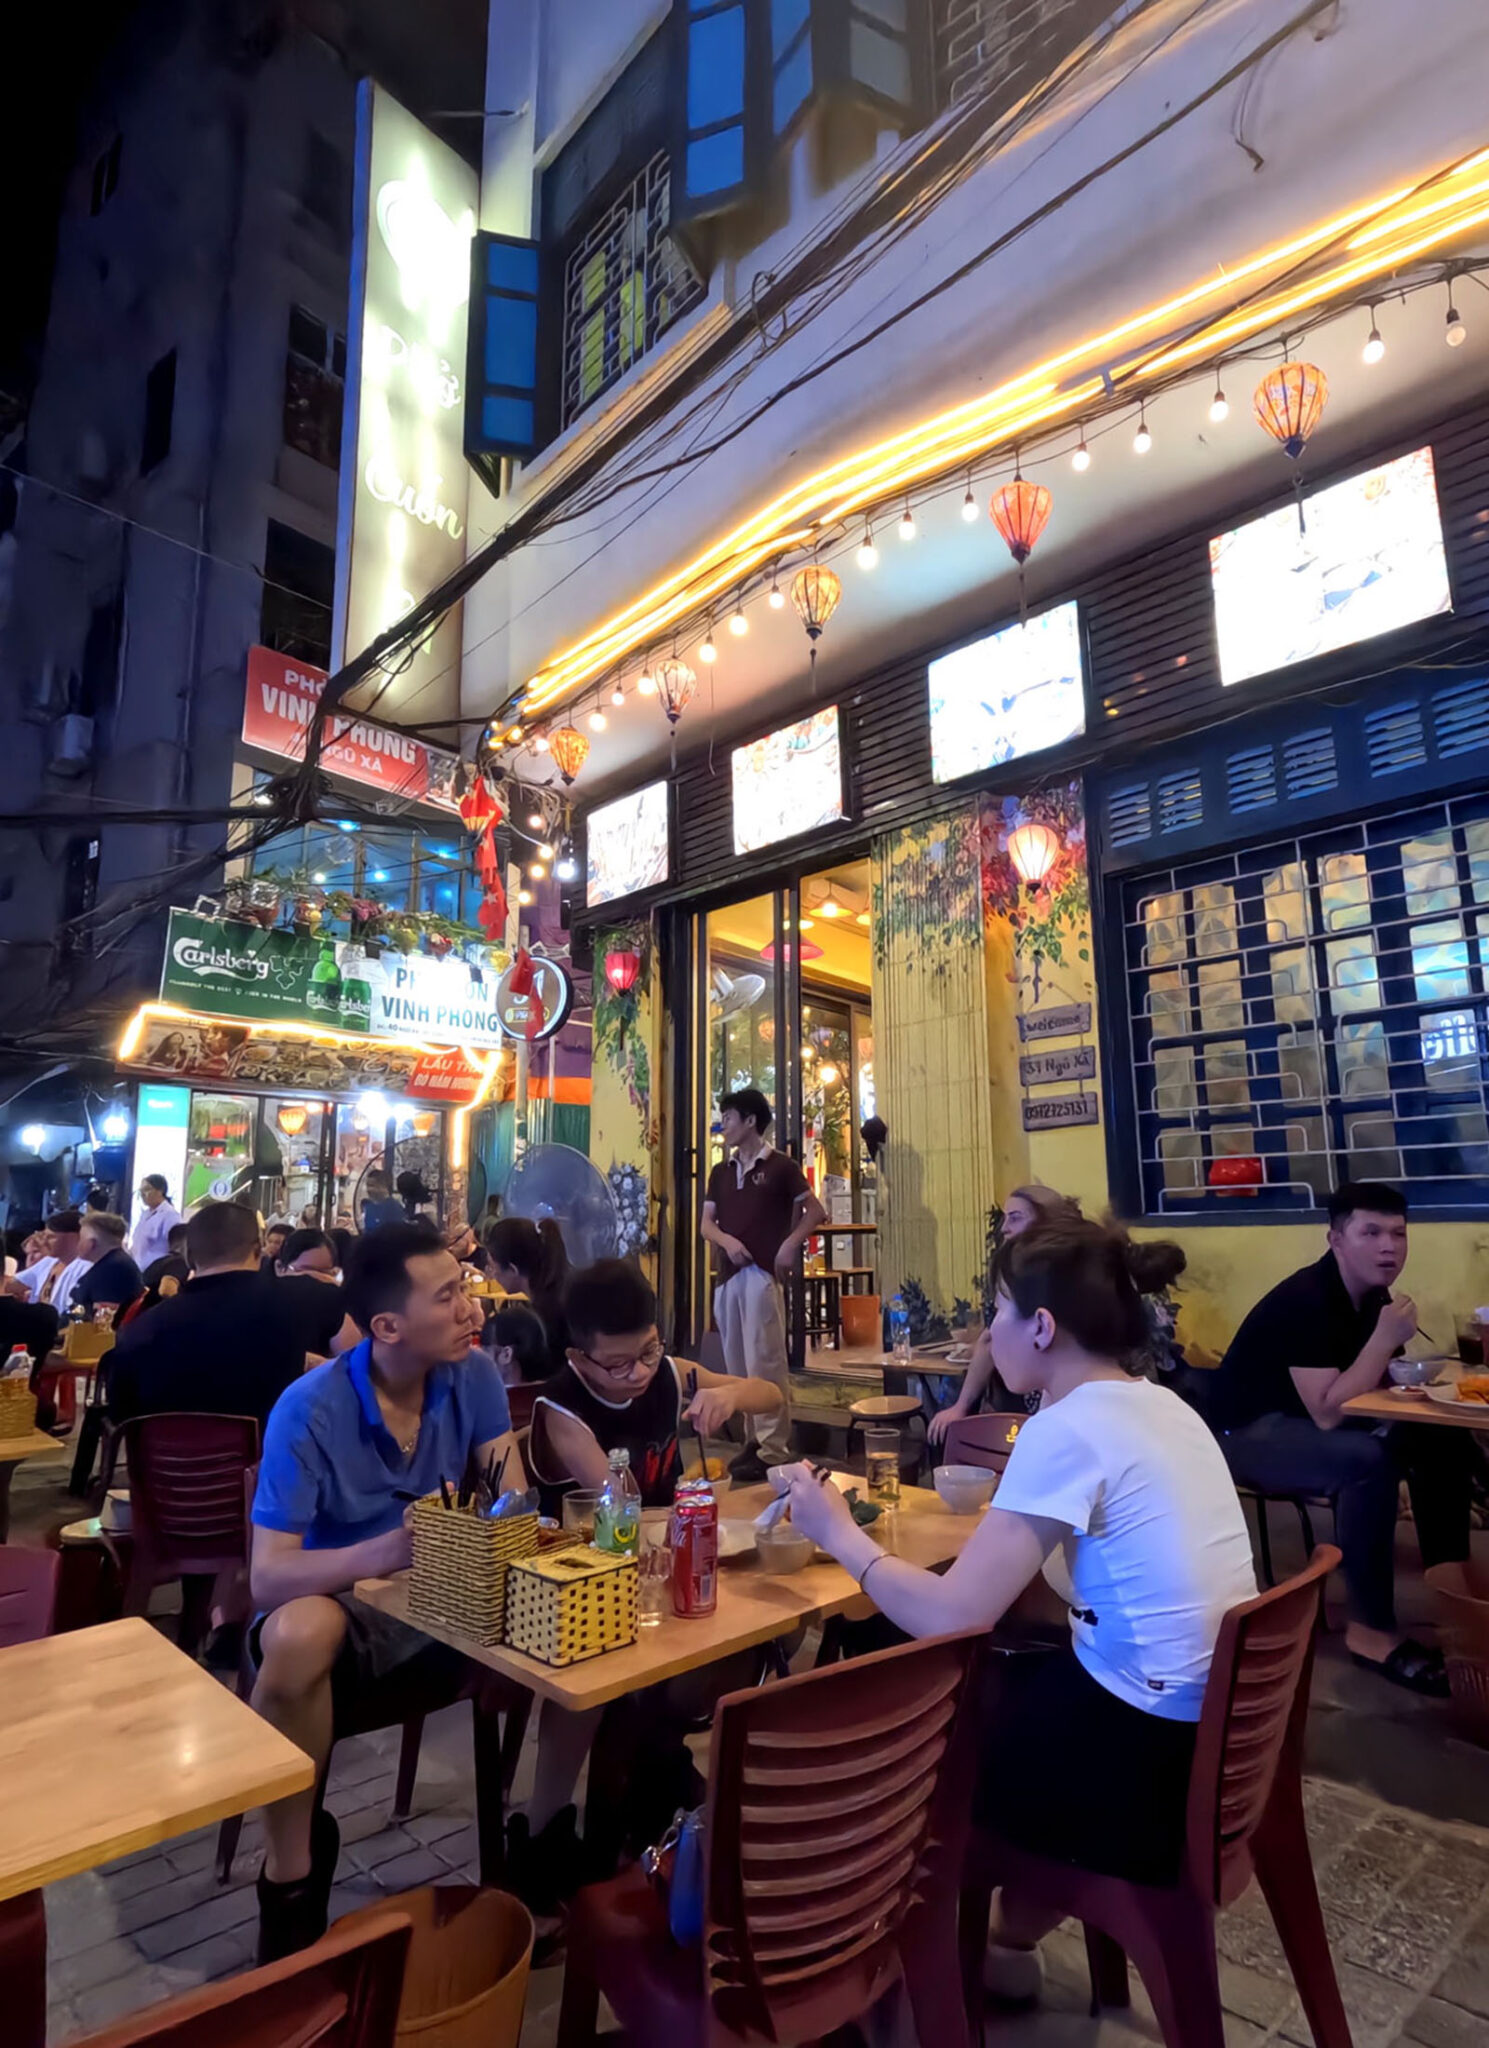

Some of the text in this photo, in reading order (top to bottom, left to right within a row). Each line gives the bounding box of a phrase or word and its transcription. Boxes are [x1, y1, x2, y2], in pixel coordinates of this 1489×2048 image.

[173, 937, 270, 979] Carlsberg
[381, 995, 498, 1033] VINH PHONG
[1026, 1058, 1042, 1075] 31
